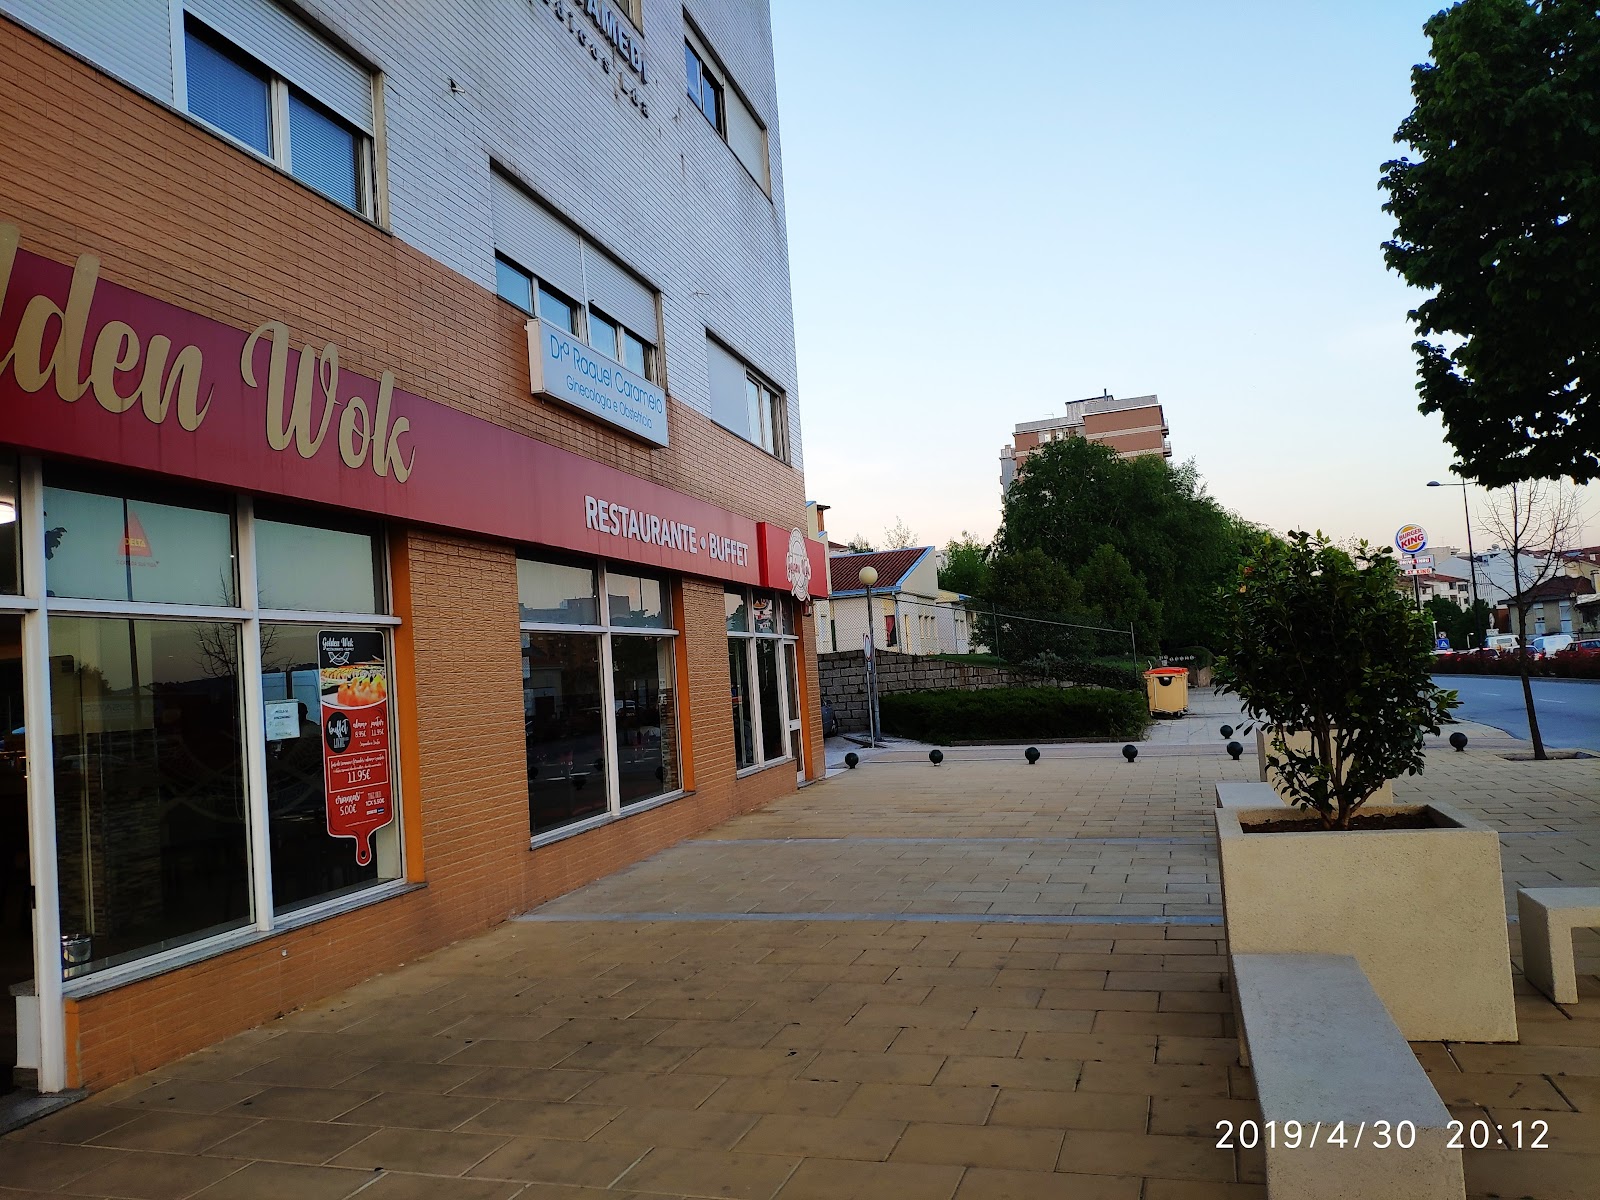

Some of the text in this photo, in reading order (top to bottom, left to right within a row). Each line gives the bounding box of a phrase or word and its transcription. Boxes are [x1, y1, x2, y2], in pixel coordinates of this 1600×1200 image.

[573, 347, 613, 388] Raquel
[614, 371, 663, 414] Caramelo
[566, 374, 612, 411] Ginecologia
[613, 402, 618, 412] e
[240, 320, 416, 484] Wok
[584, 494, 698, 554] RESTAURANTE
[707, 532, 749, 567] BUFFET
[1399, 528, 1422, 541] BURGER
[125, 538, 147, 548] DELTA
[1400, 533, 1424, 548] KING
[322, 636, 340, 651] Golden
[340, 636, 354, 648] Wok
[328, 718, 349, 738] buffet
[347, 768, 372, 784] 11.95€
[339, 803, 358, 816] 5.00€
